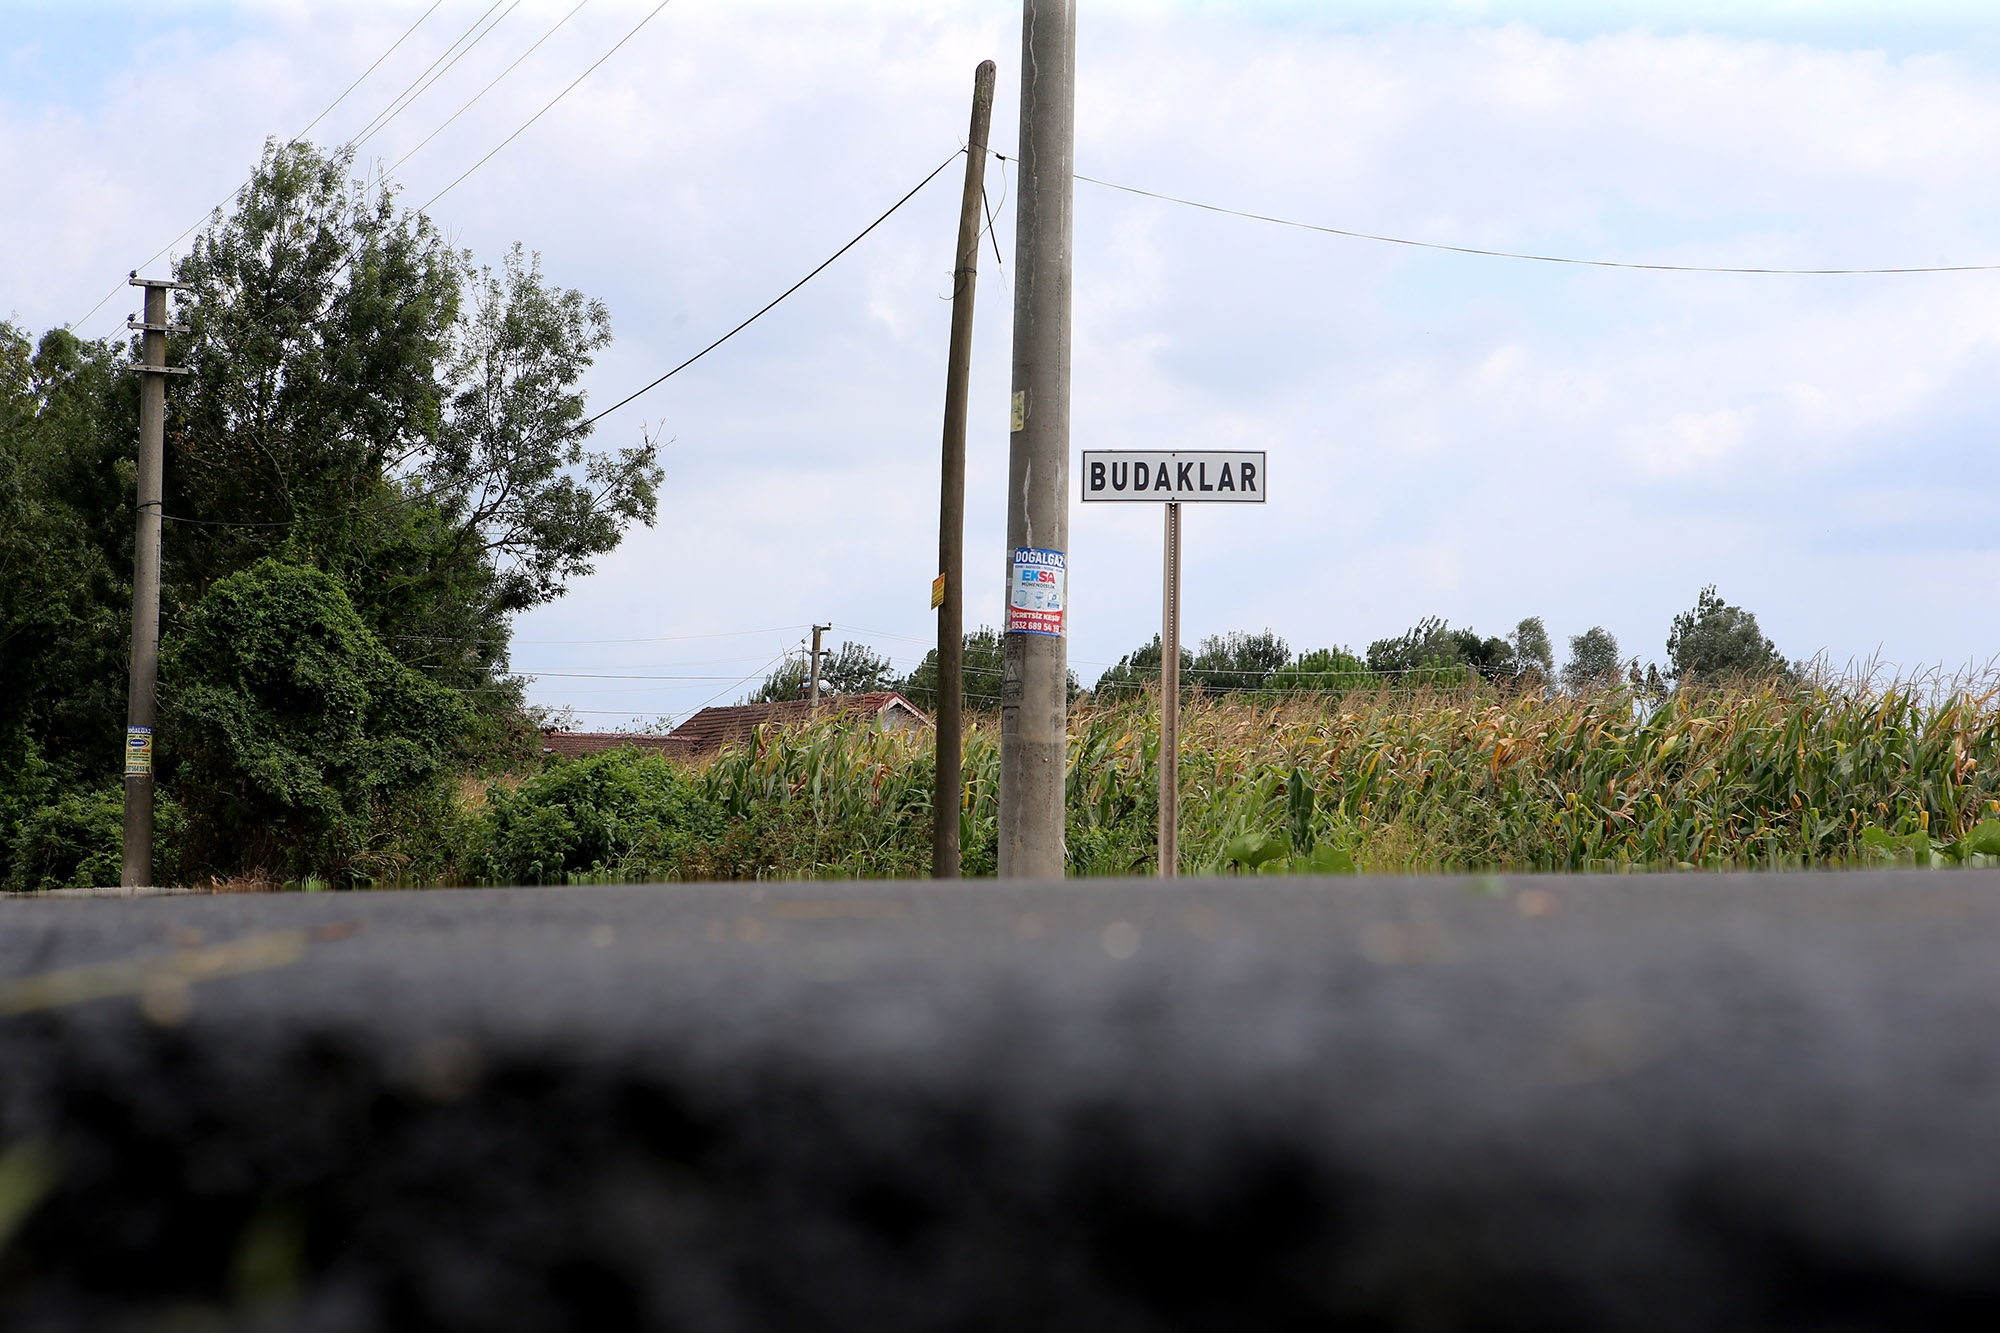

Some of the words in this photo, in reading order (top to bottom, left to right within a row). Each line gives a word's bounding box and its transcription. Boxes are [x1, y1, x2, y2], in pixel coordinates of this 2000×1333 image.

[1090, 461, 1257, 491] BUDAKLAR
[1015, 549, 1064, 567] DOĞALGAZ
[1022, 570, 1056, 584] EKSA
[1011, 621, 1027, 629] 0532
[1028, 621, 1042, 630] 689
[1043, 623, 1052, 631] 54
